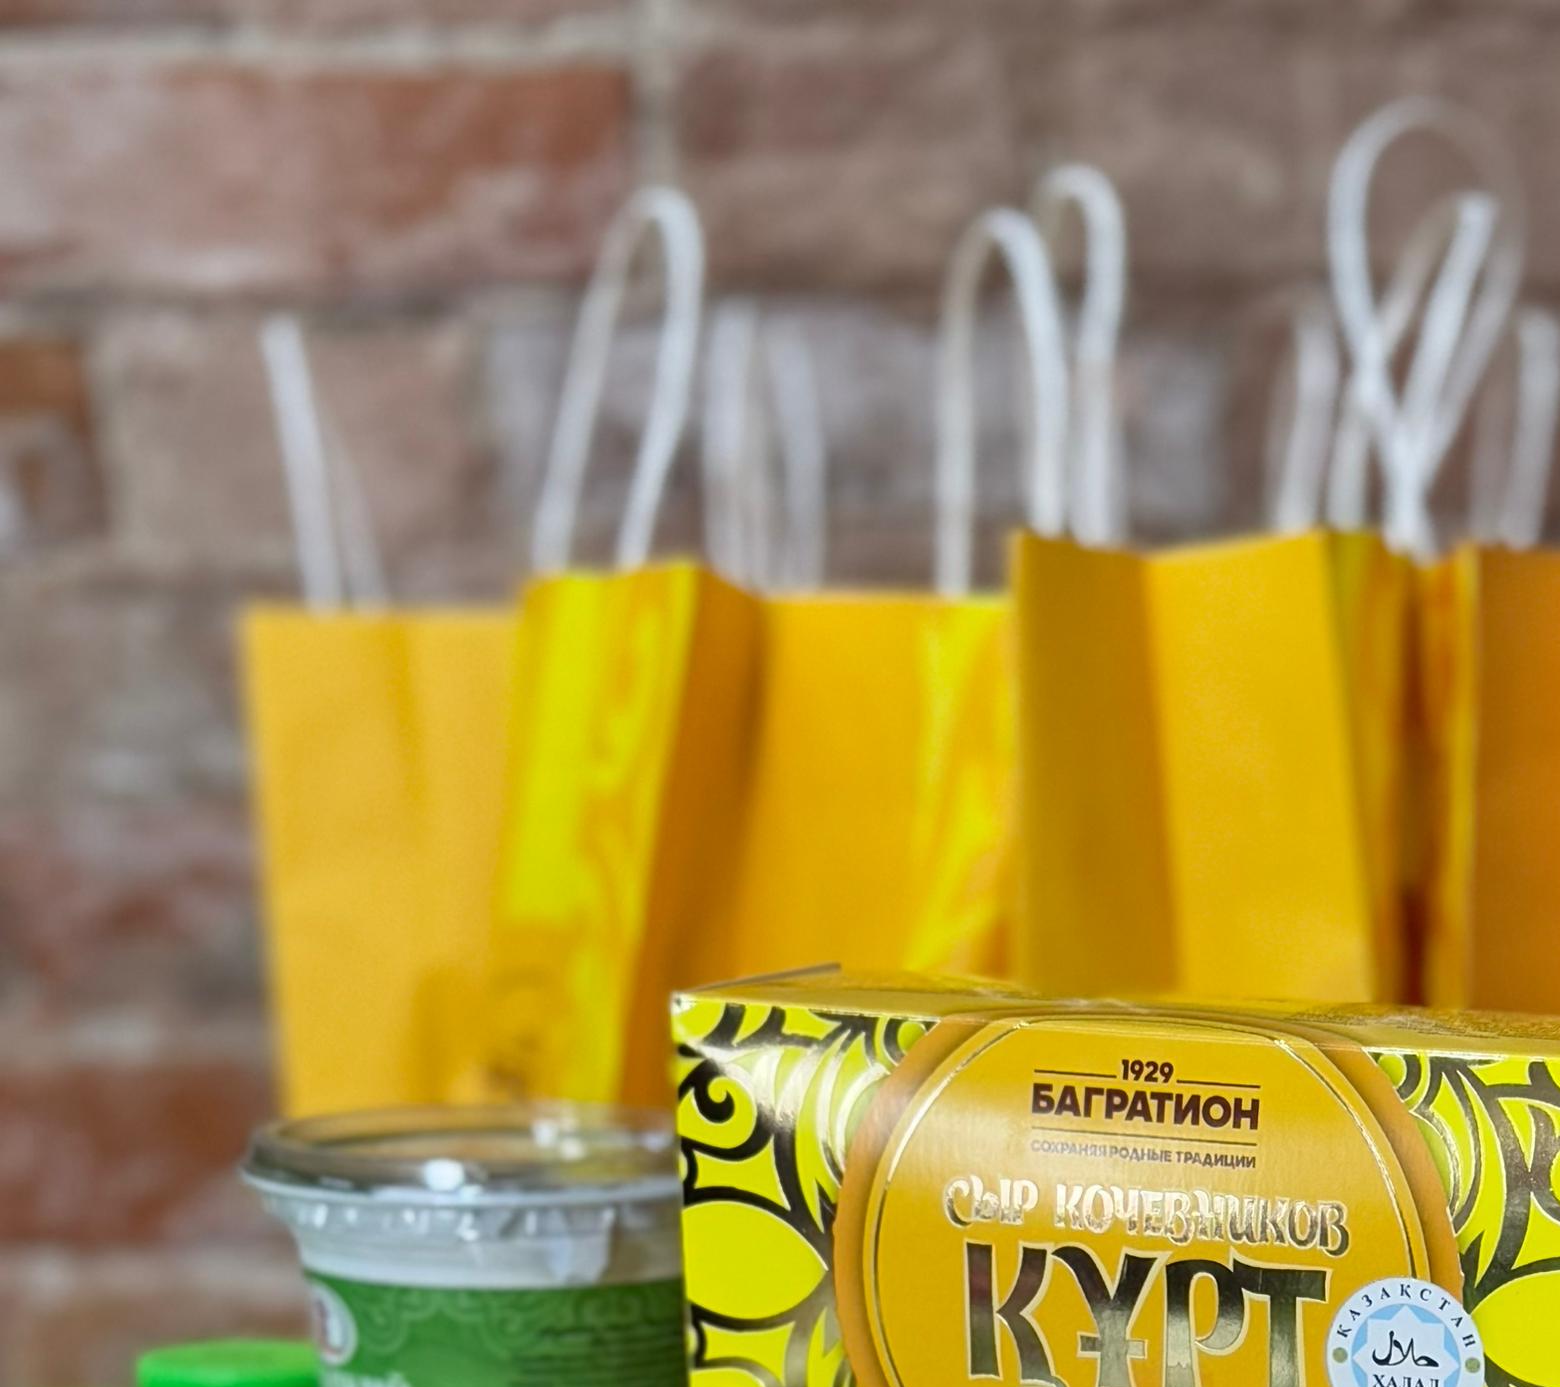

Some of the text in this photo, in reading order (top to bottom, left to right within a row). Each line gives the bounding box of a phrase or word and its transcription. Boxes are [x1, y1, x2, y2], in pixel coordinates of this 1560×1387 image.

[1121, 1059, 1174, 1083] 1929
[1031, 1082, 1260, 1130] БАГРАТИОН
[1030, 1139, 1256, 1169] СОХРАНЯЯ РОДНЫЕ ТРАДИЦИИ
[943, 1175, 1350, 1258] СЫР КОЧЕВНИКОВ
